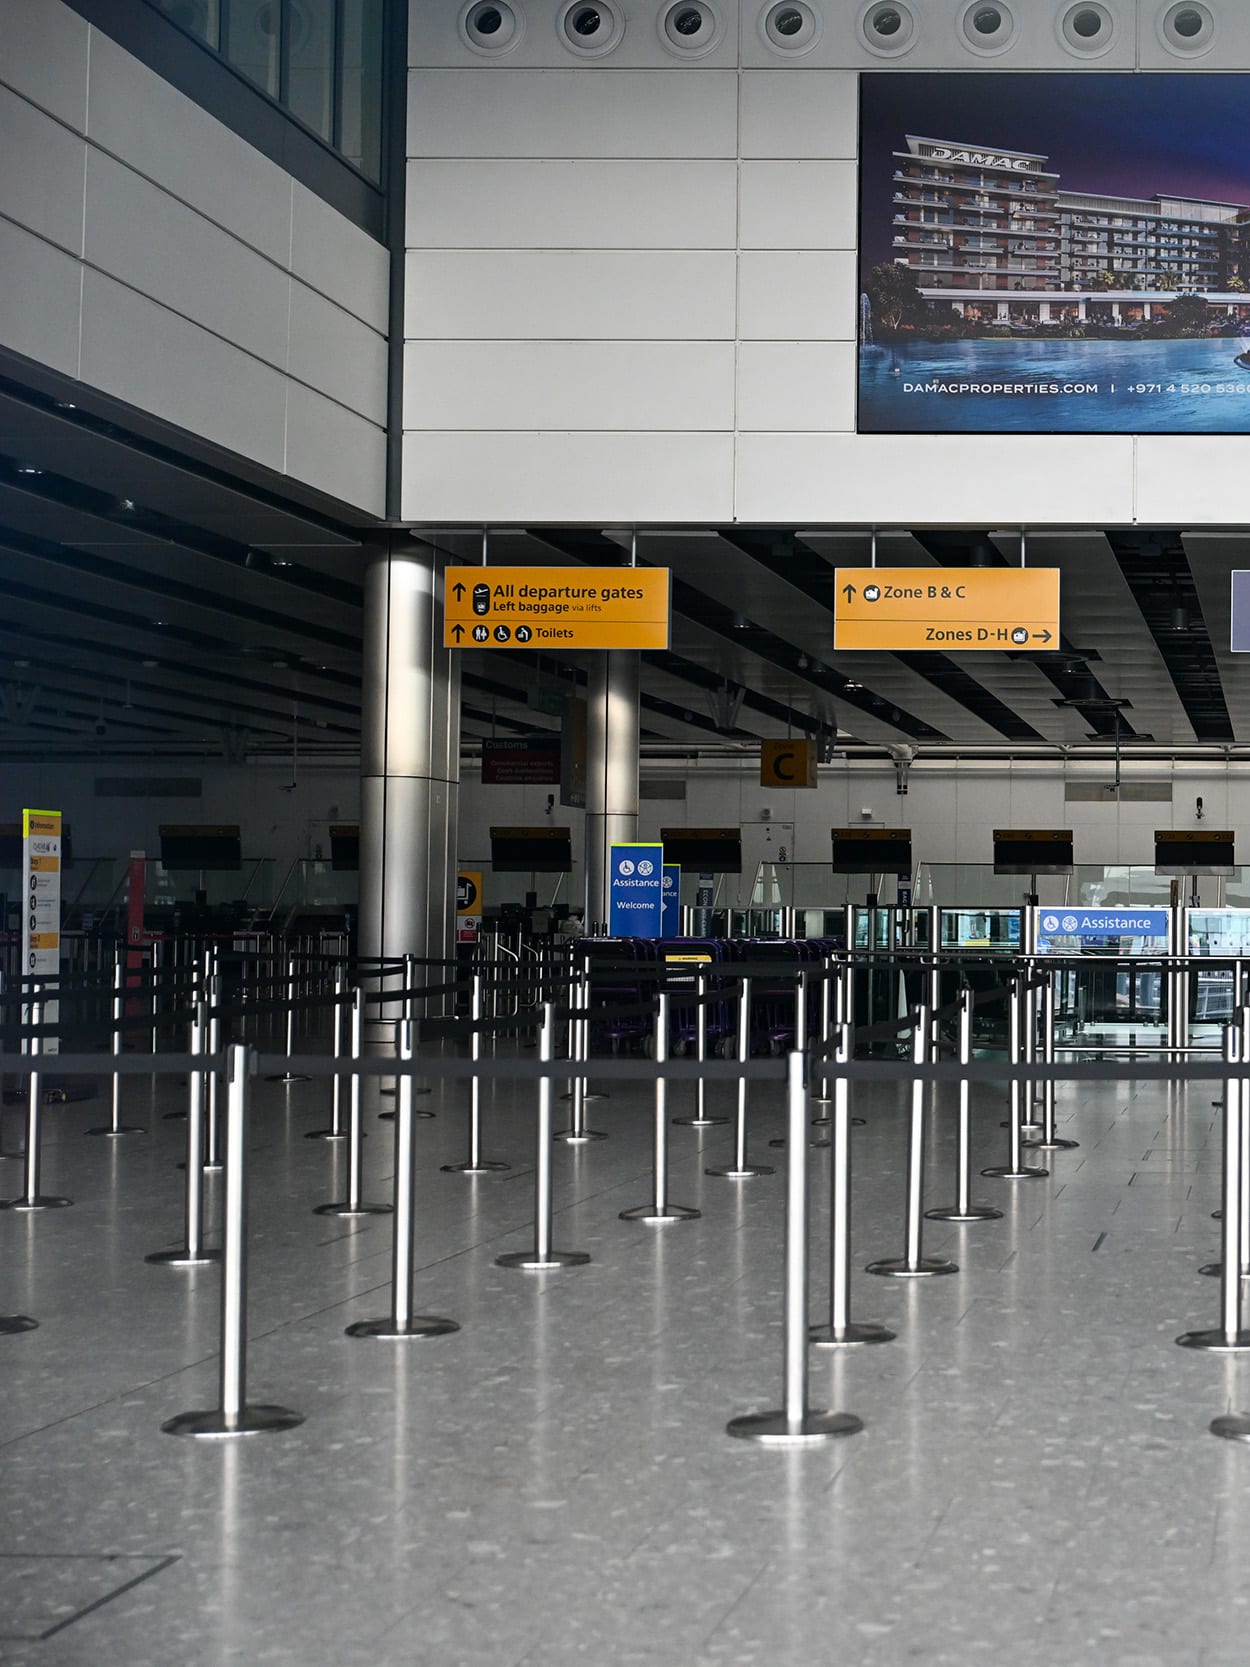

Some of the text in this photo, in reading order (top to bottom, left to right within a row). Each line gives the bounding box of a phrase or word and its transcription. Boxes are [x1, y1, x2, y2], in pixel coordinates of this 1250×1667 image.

[931, 147, 1031, 170] DAMAC
[903, 383, 1099, 394] DAMACPROPERTIES.COM
[1127, 383, 1162, 394] +971
[1165, 383, 1176, 394] 4
[1180, 383, 1212, 394] 520
[493, 585, 644, 601] All departure gates
[884, 586, 966, 599] Zone B & C
[493, 601, 602, 614] Left baggage via lifts
[535, 627, 574, 638] Toilets
[925, 628, 1009, 641] Zones D-H
[485, 740, 529, 750] Customs
[773, 753, 794, 780] C
[613, 879, 660, 888] Assistance
[616, 901, 655, 910] Welcome
[1081, 916, 1151, 929] Assistance
